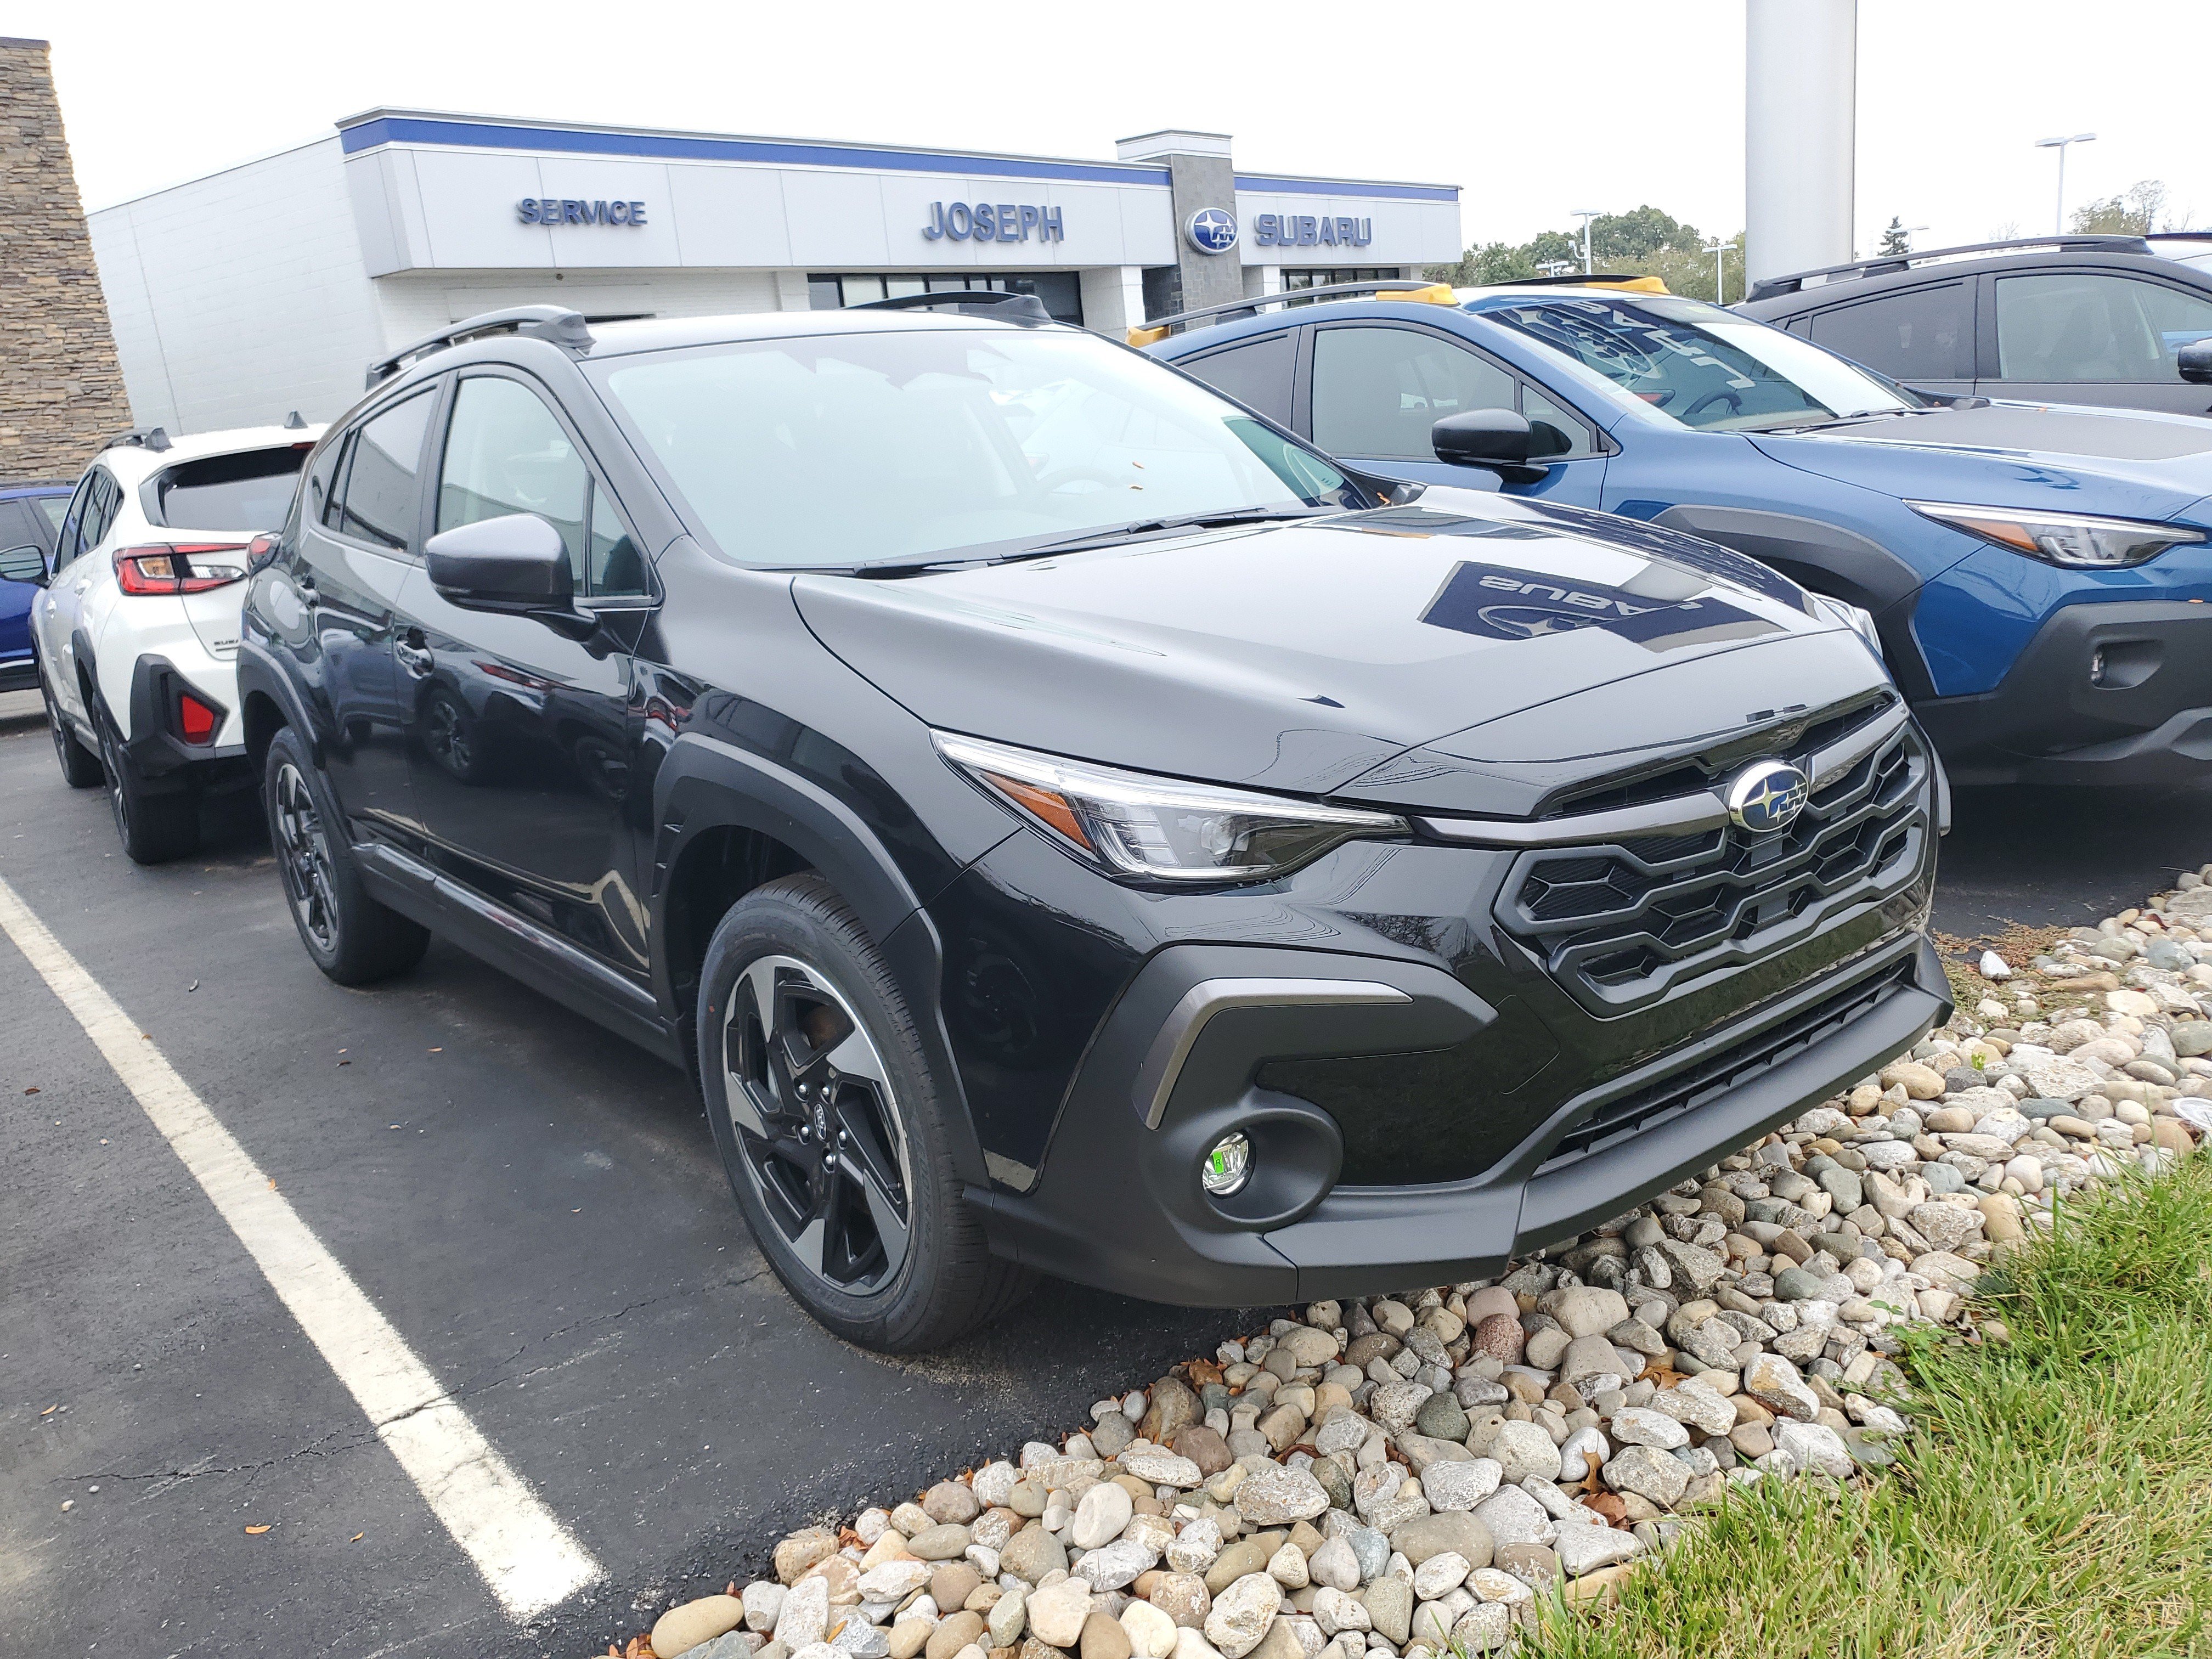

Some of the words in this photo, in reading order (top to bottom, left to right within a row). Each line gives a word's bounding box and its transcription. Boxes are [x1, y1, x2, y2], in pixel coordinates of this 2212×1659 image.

[518, 198, 647, 225] SERVICE
[922, 201, 1064, 242] JOSEPH
[1255, 214, 1371, 247] SUBARU
